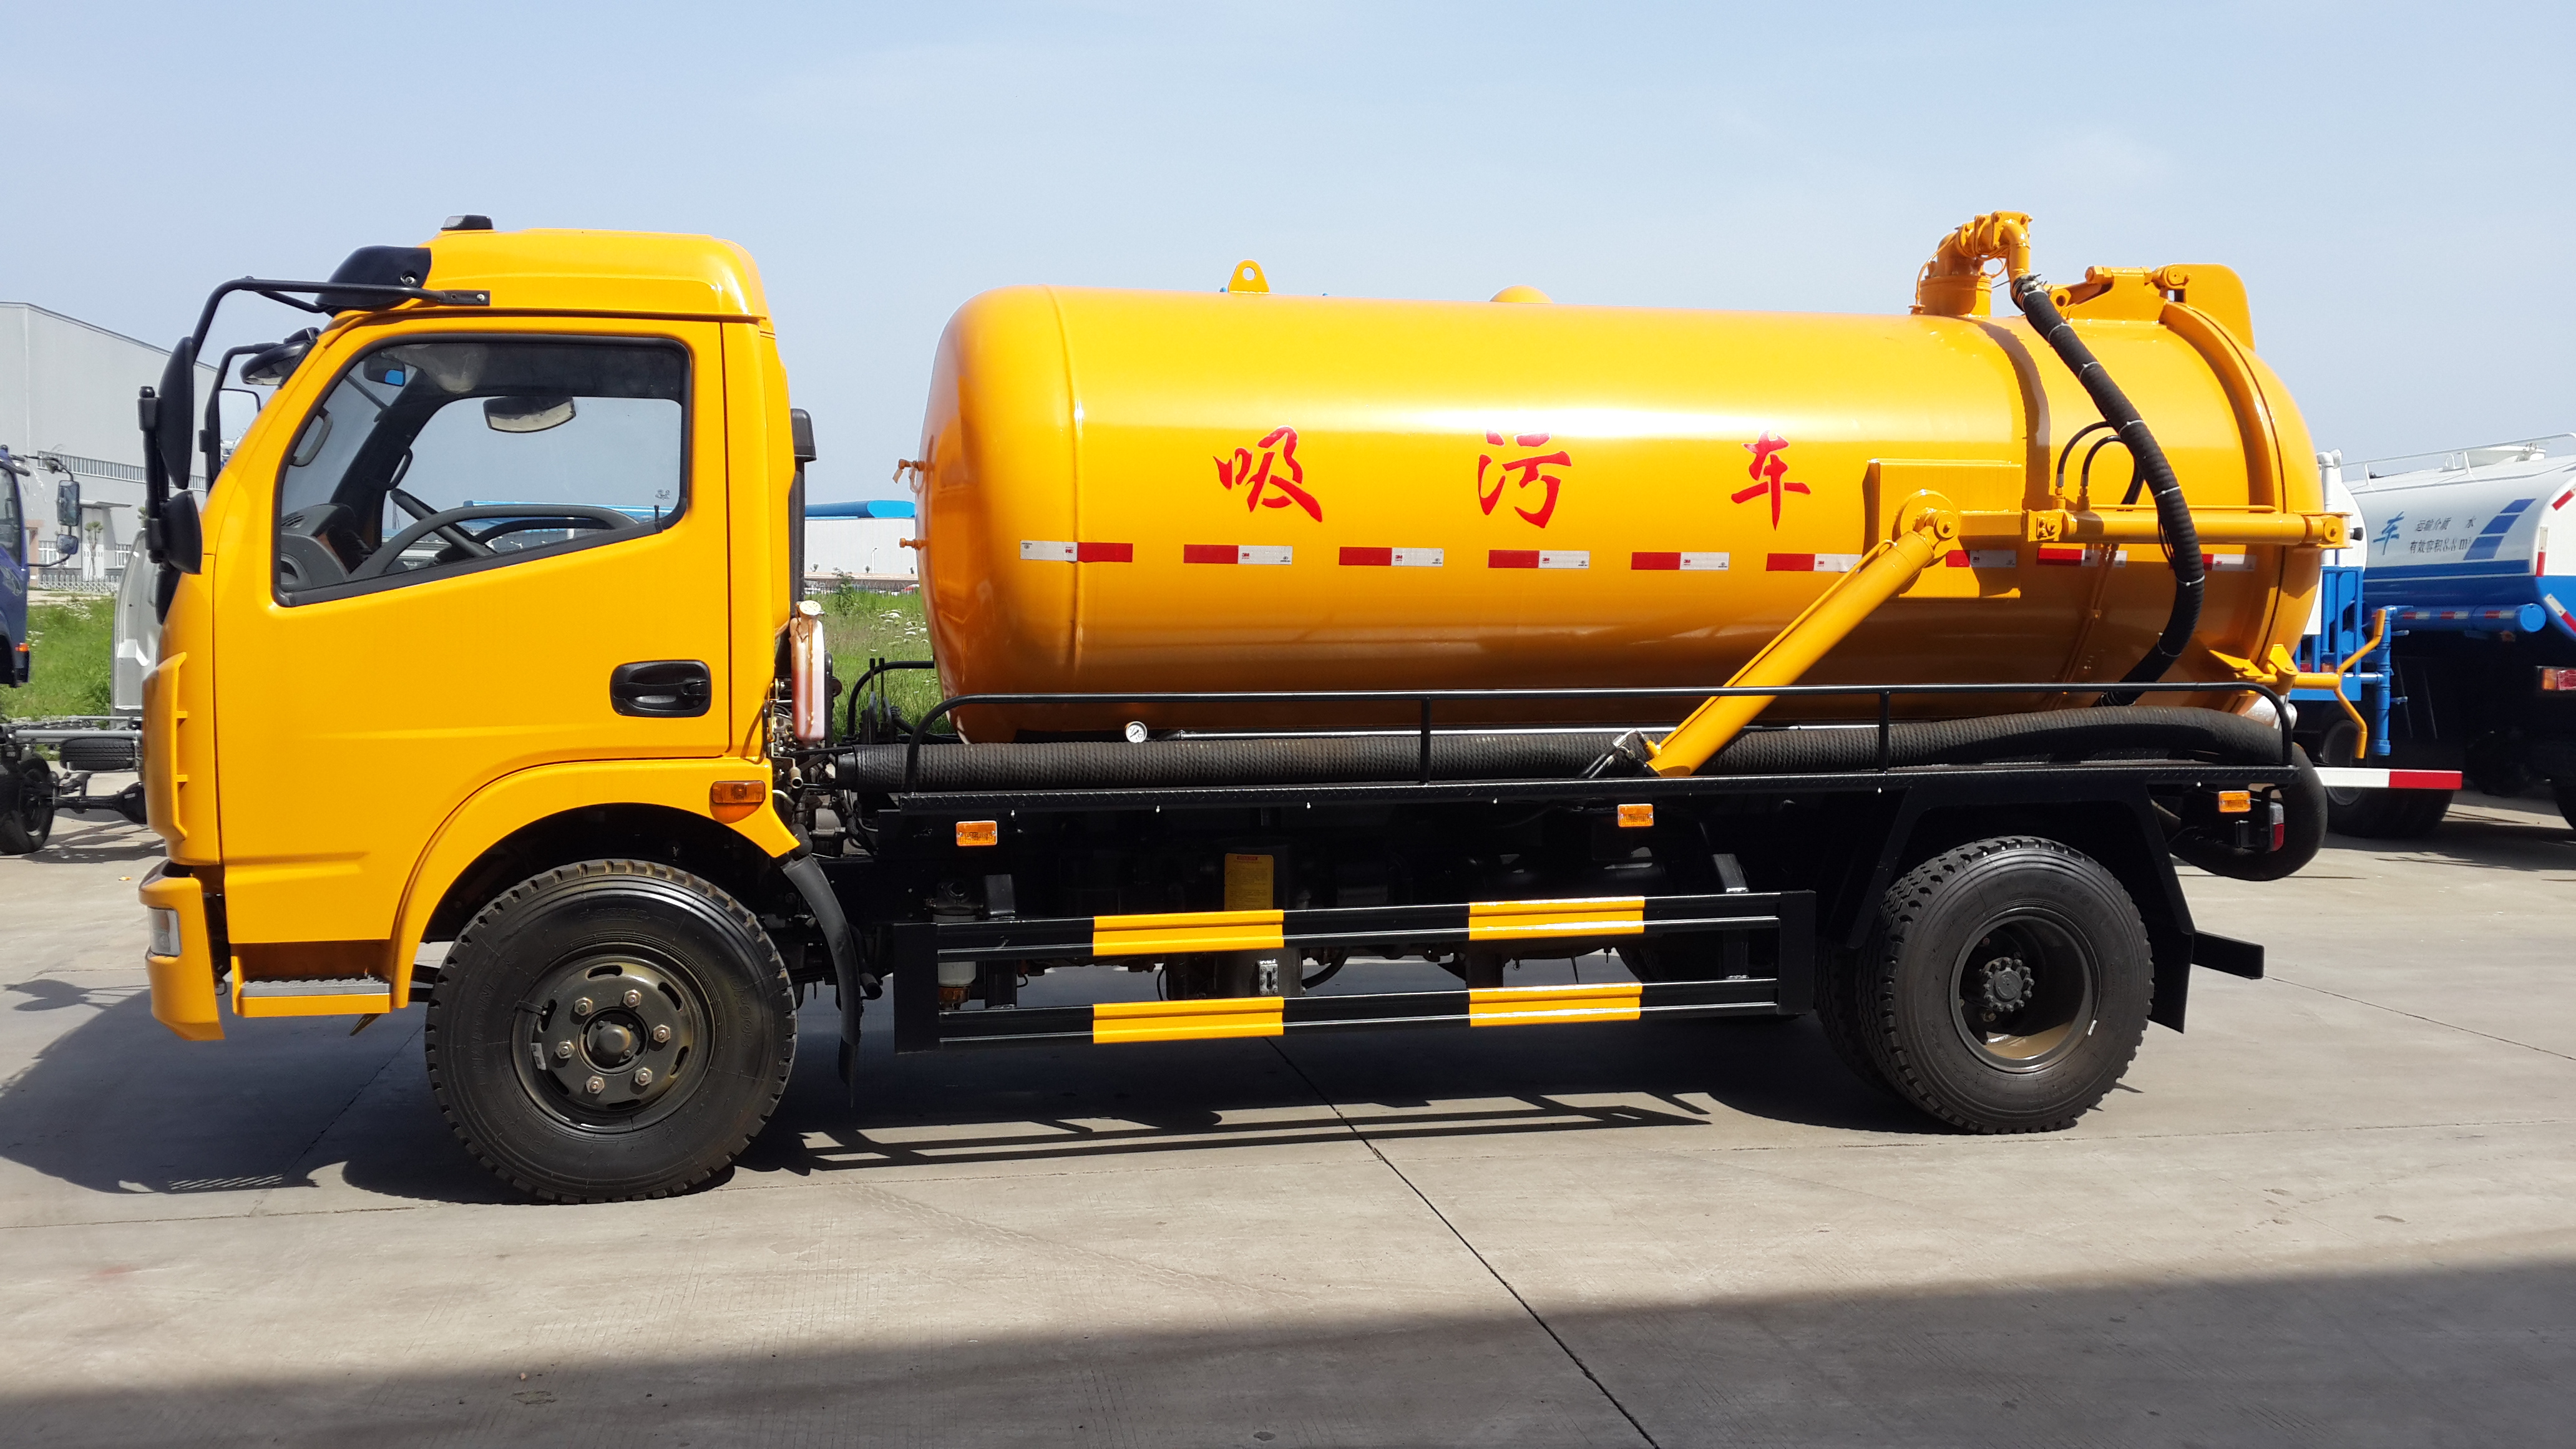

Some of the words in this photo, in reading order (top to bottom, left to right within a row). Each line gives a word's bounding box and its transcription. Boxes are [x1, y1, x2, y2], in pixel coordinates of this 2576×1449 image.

[2373, 511, 2405, 555] 车
[2415, 517, 2452, 532] 运输介质
[2466, 515, 2477, 529] 水
